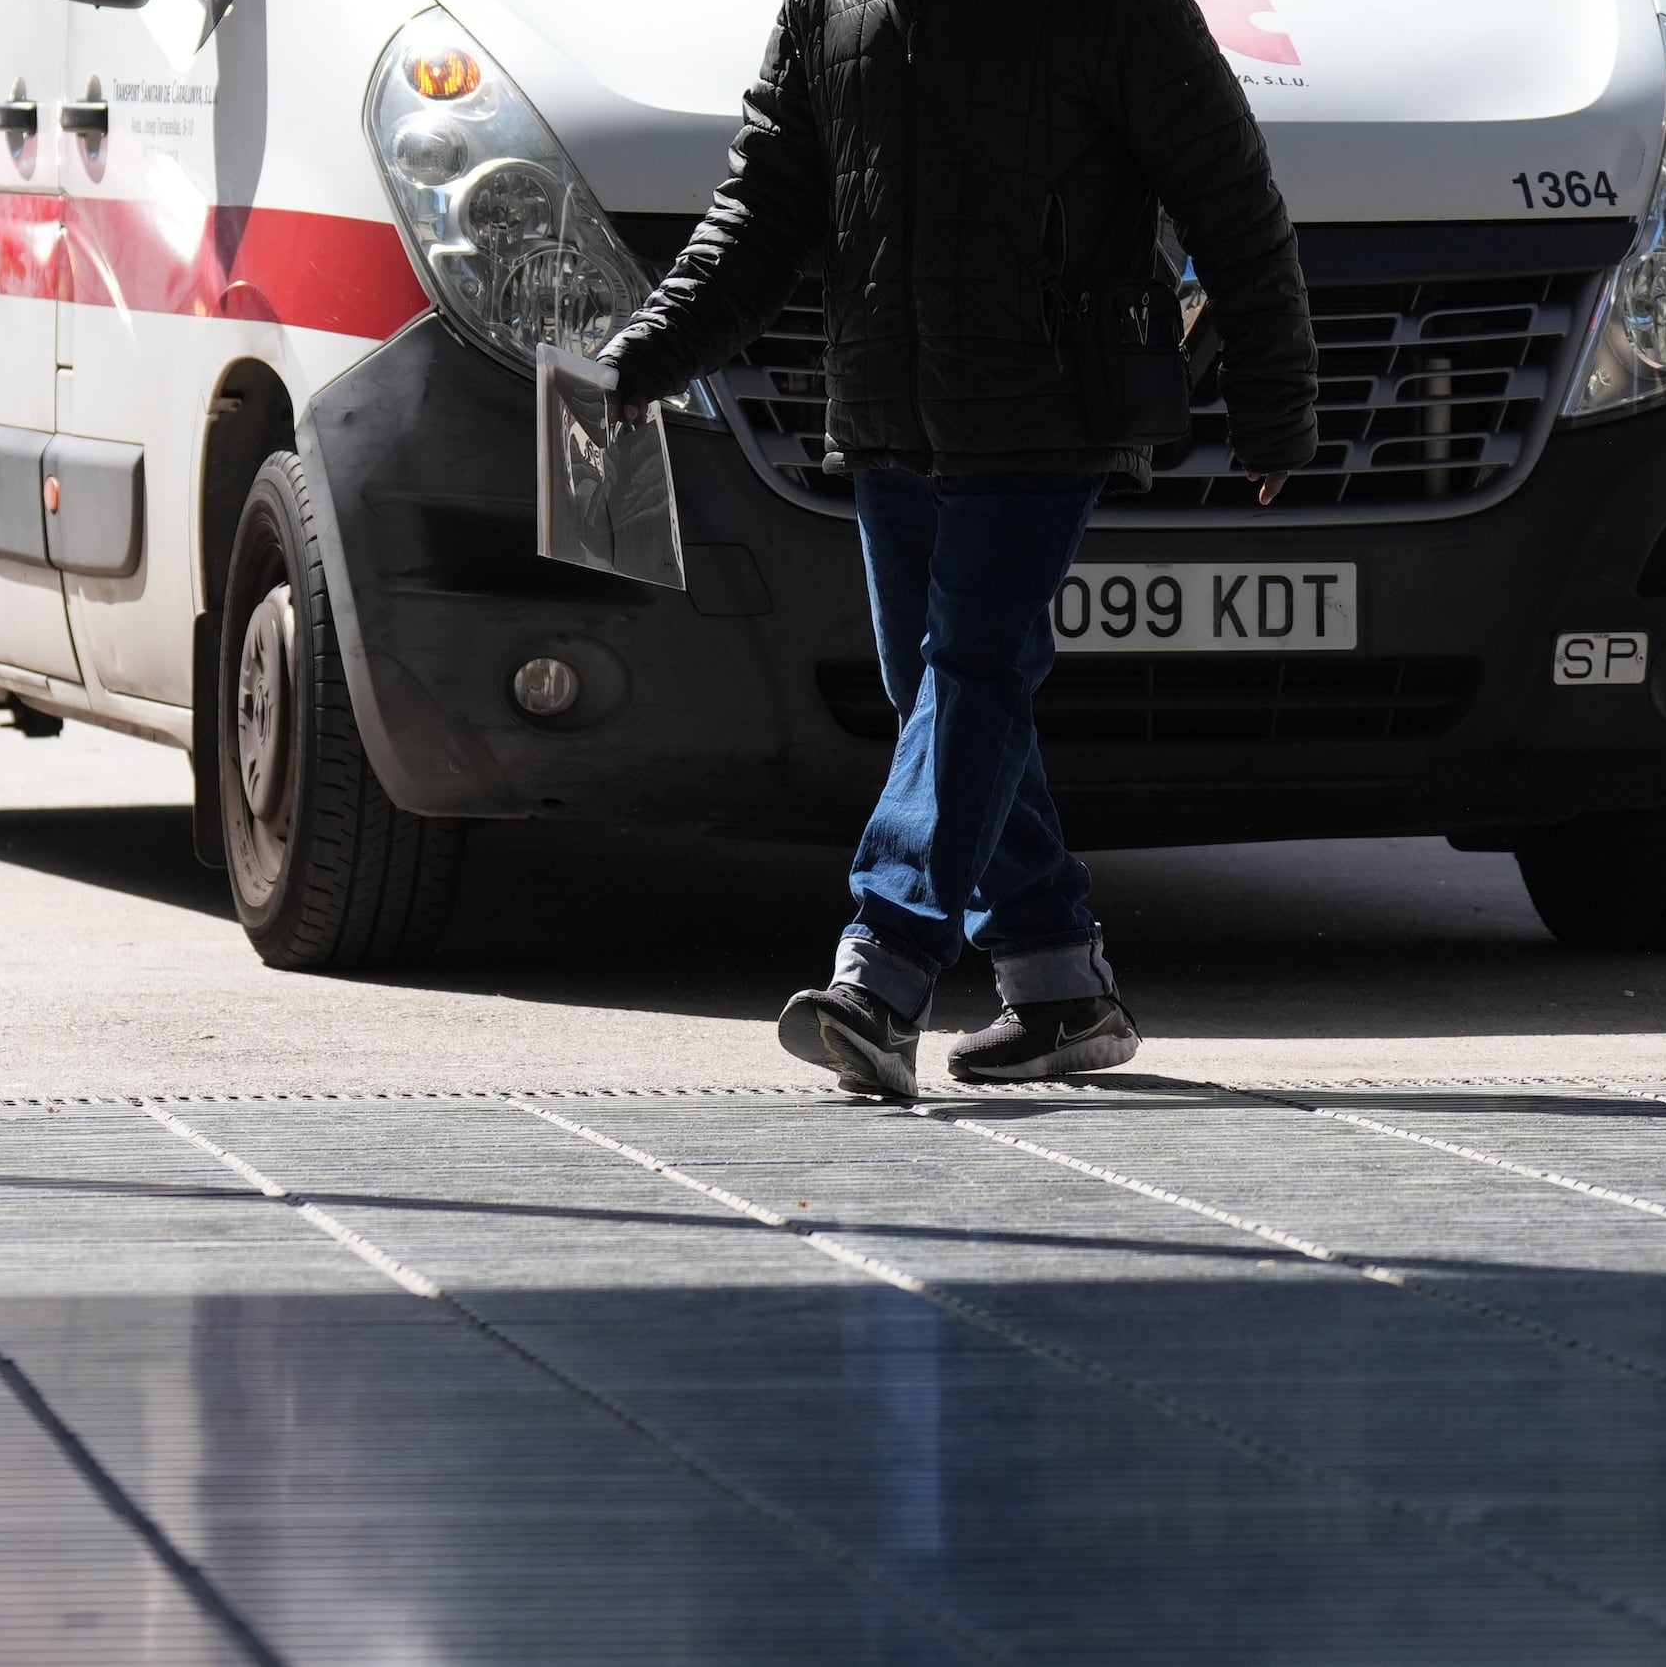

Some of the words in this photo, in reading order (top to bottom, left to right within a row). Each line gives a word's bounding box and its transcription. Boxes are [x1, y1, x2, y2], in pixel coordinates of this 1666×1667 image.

[1264, 75, 1310, 88] S.L.U.
[1512, 170, 1618, 210] 1364
[1212, 574, 1339, 638] KDT
[1563, 637, 1638, 679] SP
